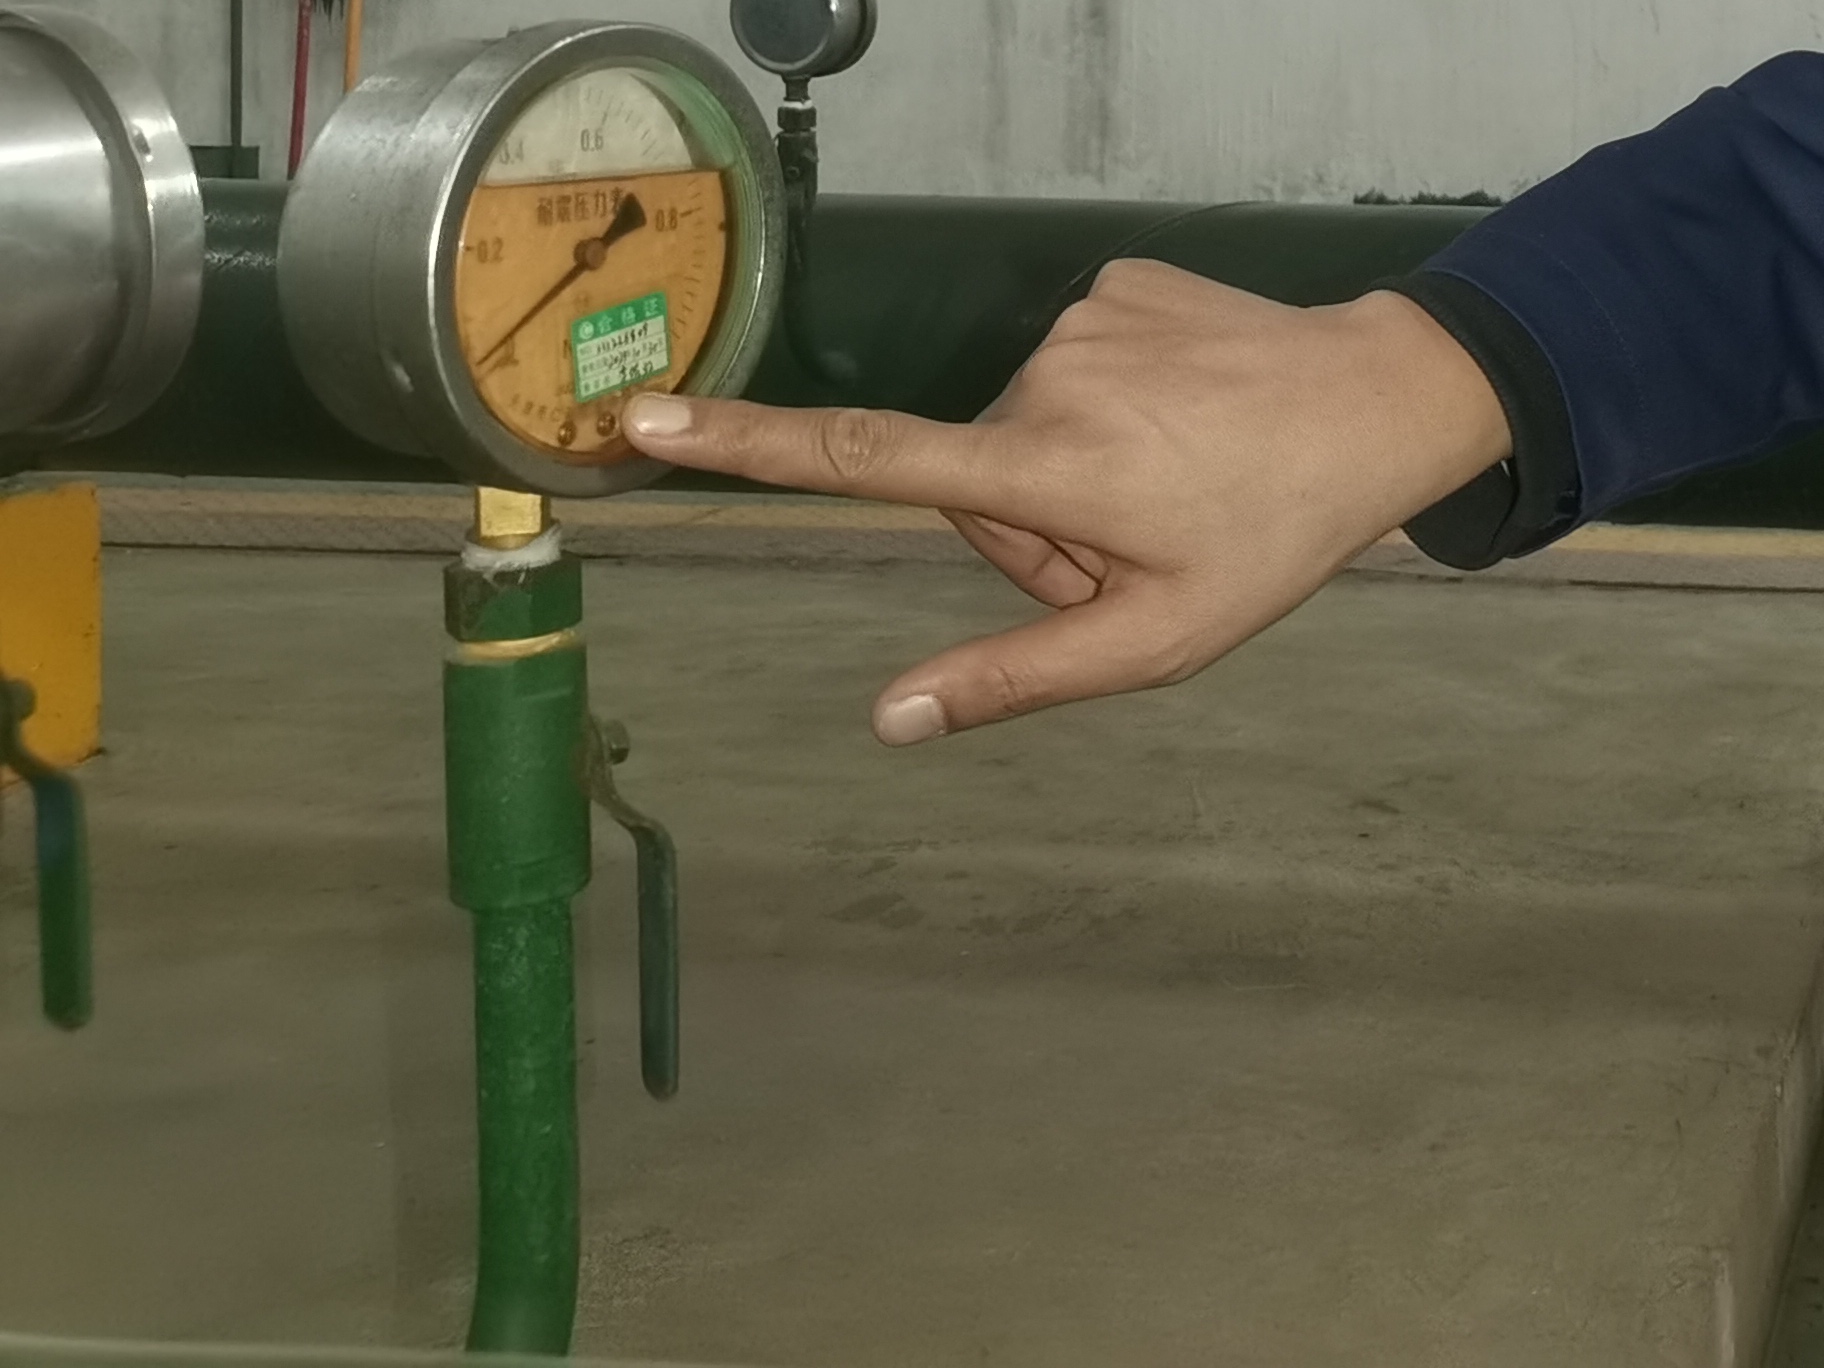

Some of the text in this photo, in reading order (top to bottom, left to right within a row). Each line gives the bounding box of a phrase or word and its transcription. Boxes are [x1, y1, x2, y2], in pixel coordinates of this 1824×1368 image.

[580, 128, 604, 152] 0.6
[655, 207, 679, 232] 0.8
[477, 236, 504, 264] 0.2
